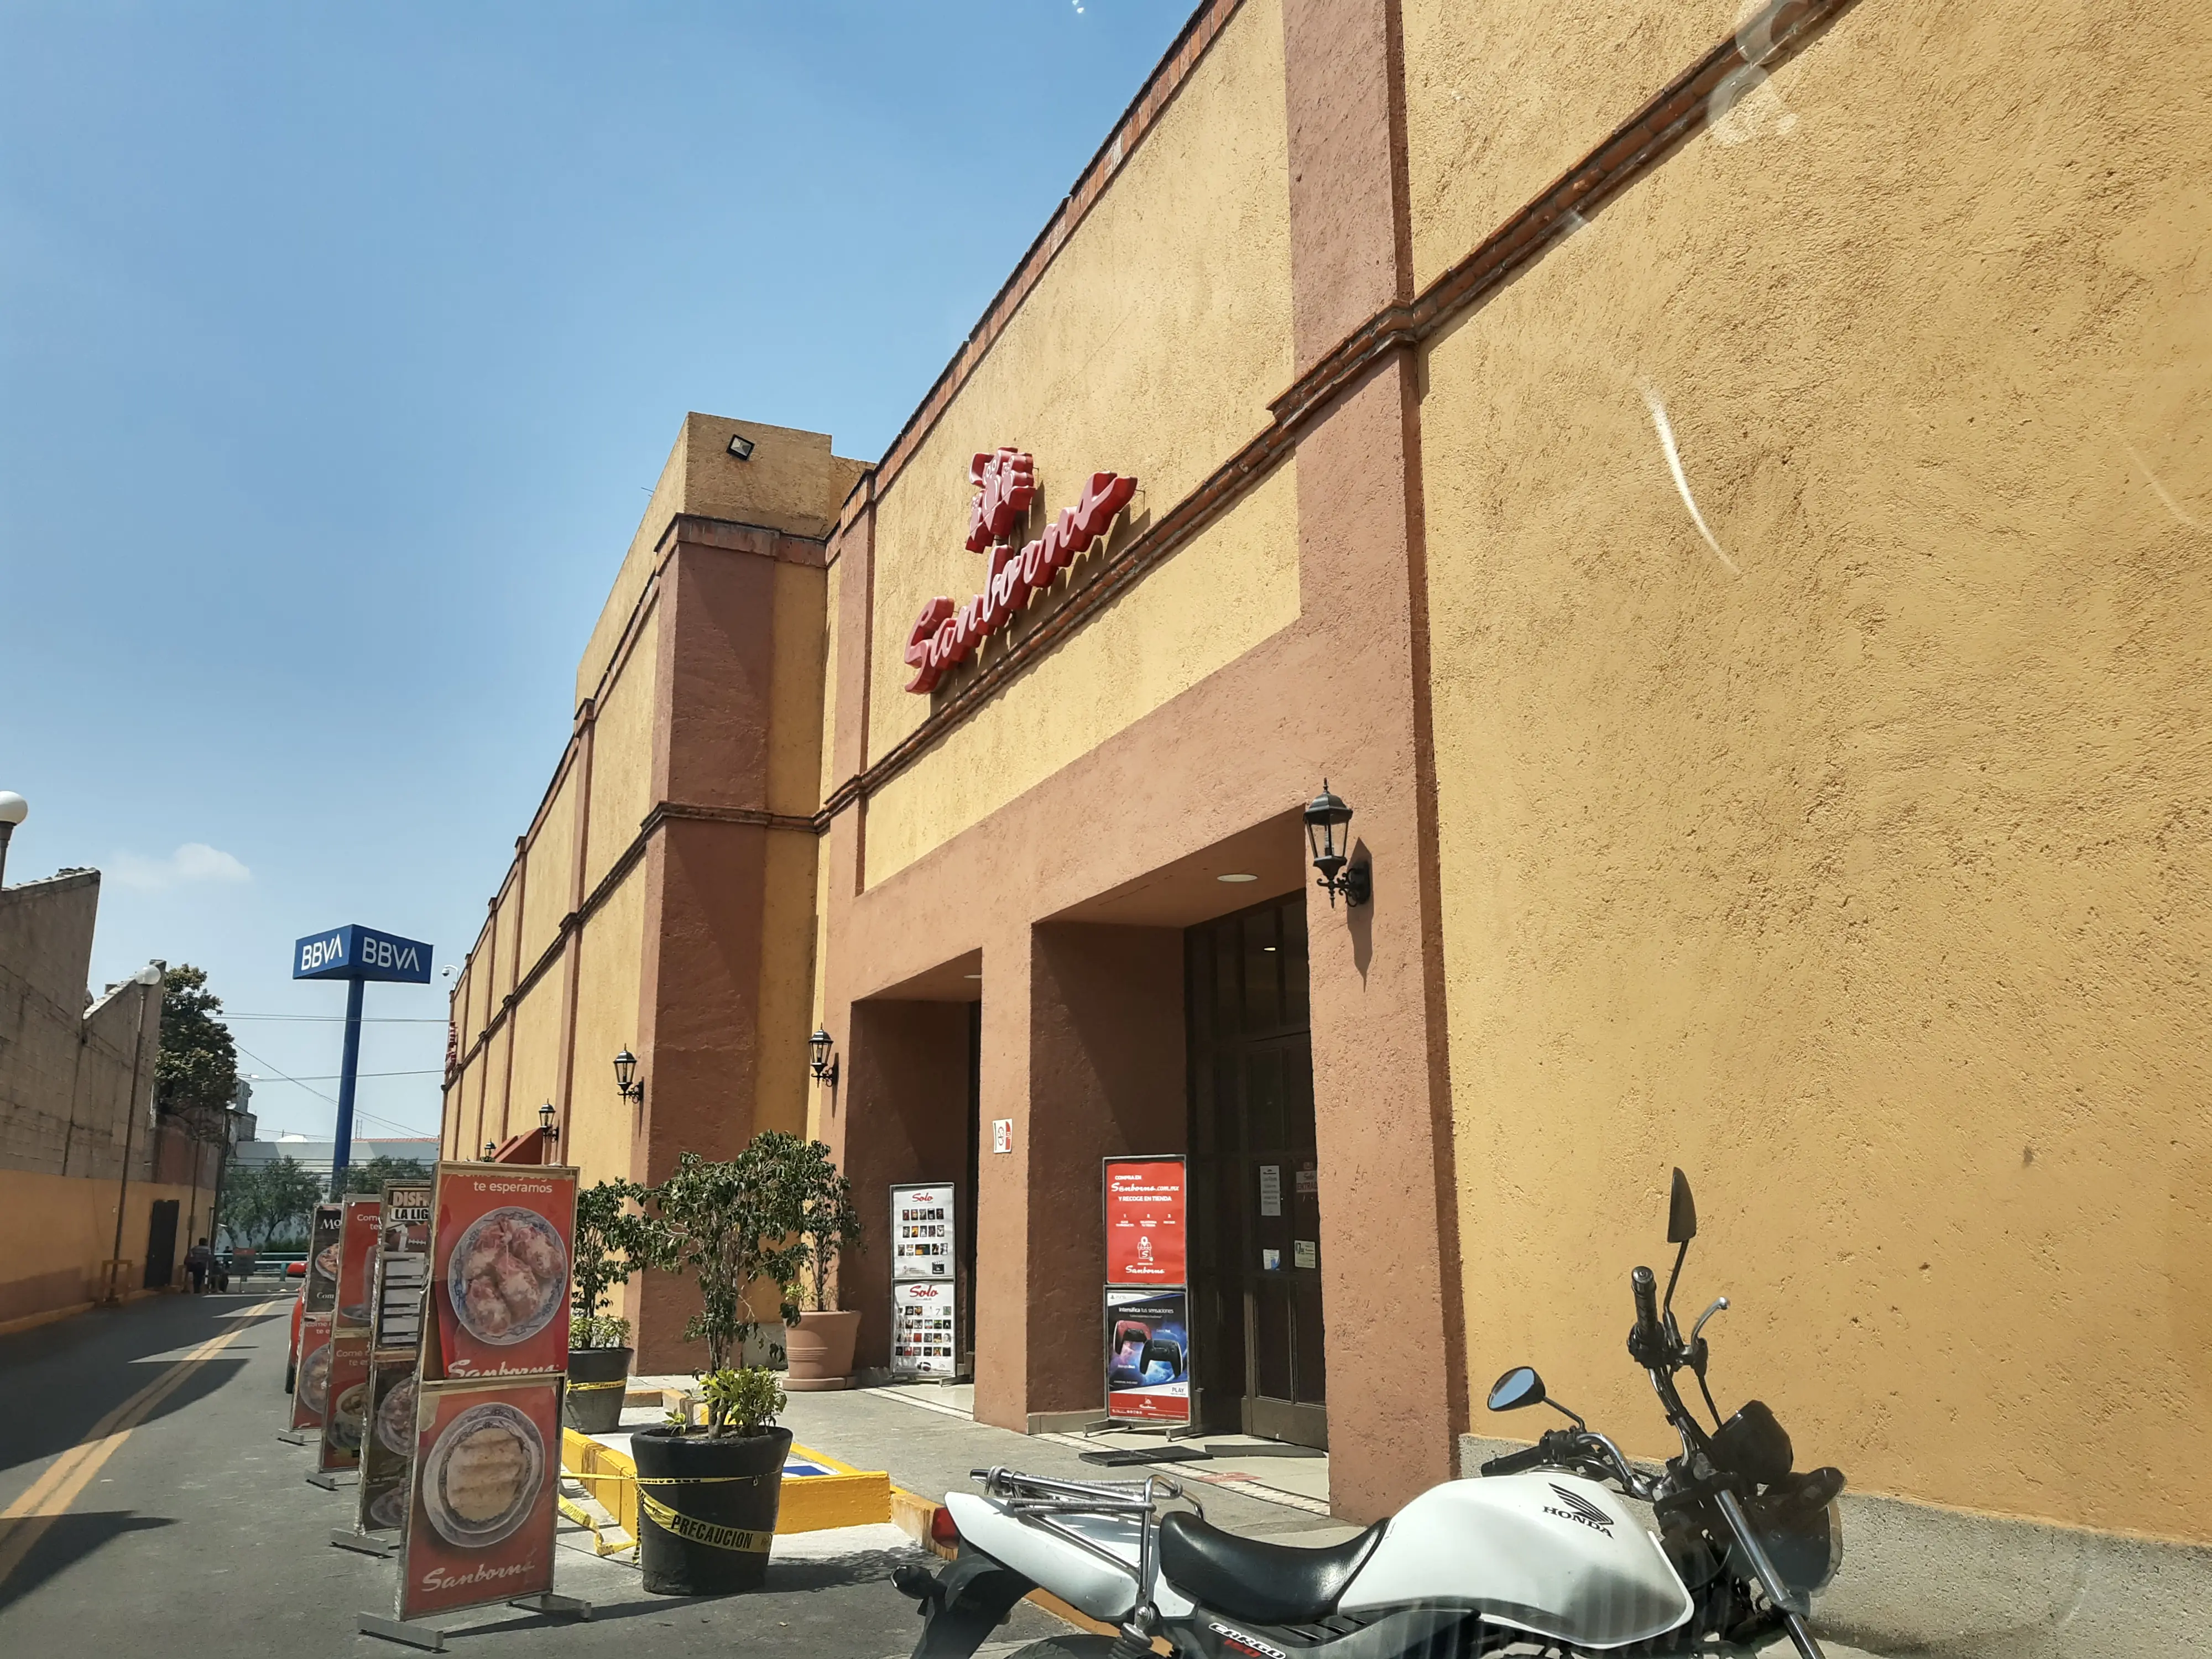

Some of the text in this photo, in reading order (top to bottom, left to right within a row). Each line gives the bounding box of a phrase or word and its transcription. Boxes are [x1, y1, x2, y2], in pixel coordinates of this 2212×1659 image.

[904, 471, 1138, 695] Sanborns
[301, 933, 342, 971] BBVA
[362, 936, 420, 972] BBVA
[474, 1181, 552, 1194] te esperamos
[911, 1192, 933, 1202] Solo
[395, 1209, 408, 1219] LA
[1125, 1265, 1165, 1274] Sanborns
[909, 1285, 938, 1298] Solo
[336, 1349, 363, 1358] Come
[670, 1514, 754, 1549] PRECAUCION
[1542, 1506, 1615, 1540] HONDA
[421, 1563, 536, 1592] Sanborns
[1208, 1623, 1286, 1659] CARGO
